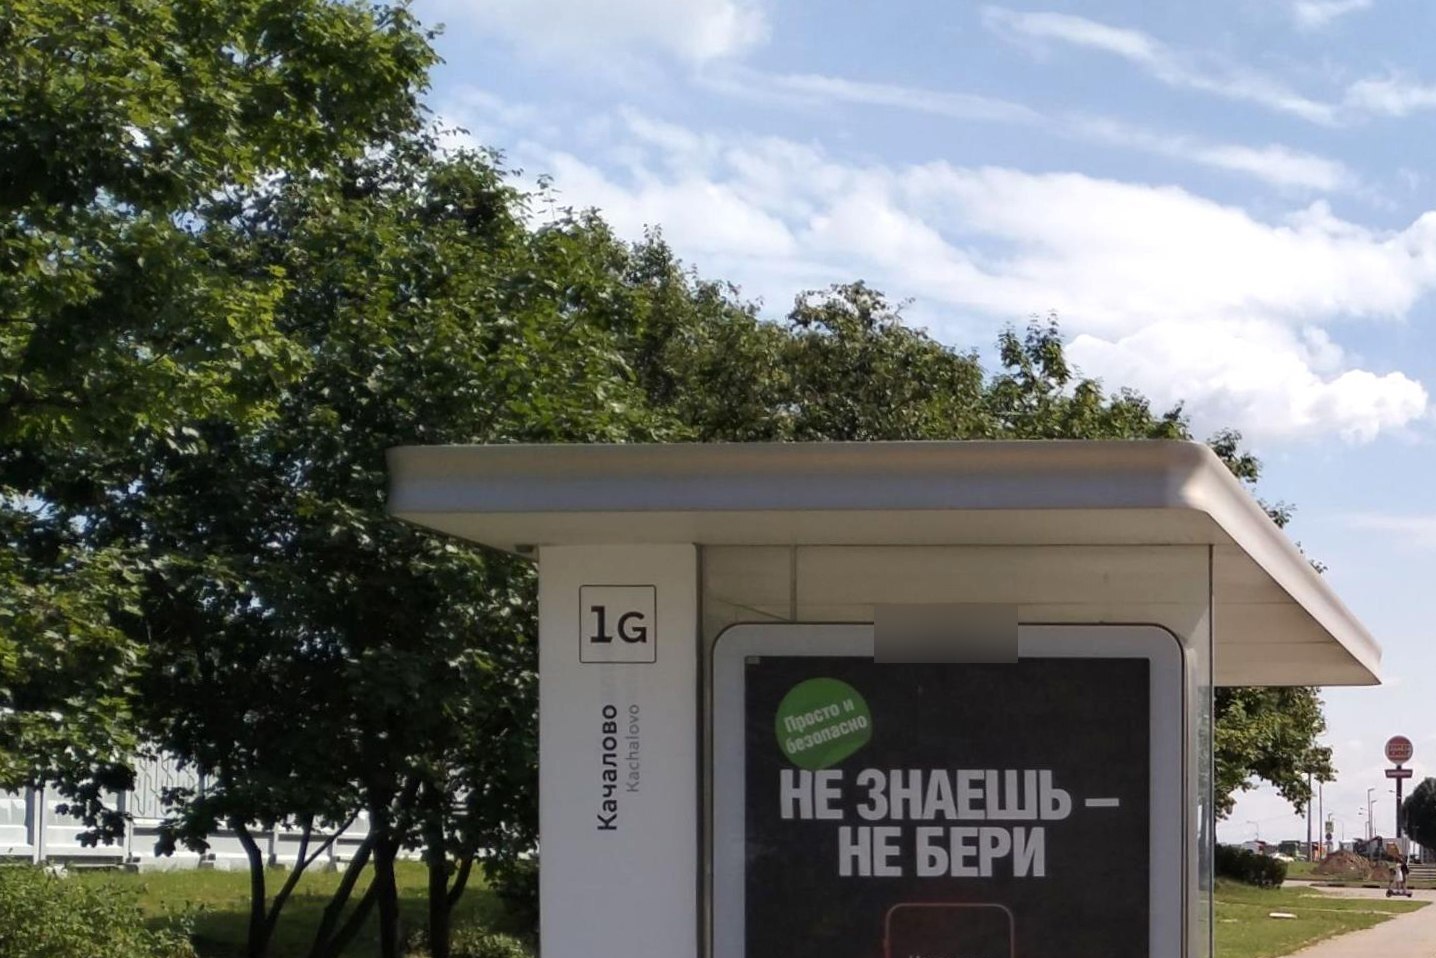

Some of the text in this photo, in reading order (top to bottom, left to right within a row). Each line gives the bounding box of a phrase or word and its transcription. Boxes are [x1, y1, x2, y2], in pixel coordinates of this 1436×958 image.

[590, 605, 648, 644] 1G
[784, 698, 855, 733] Просто и
[785, 715, 868, 754] безопасно
[597, 704, 618, 831] Качалово
[626, 704, 640, 793] Kachalovo
[779, 769, 844, 820] НЕ
[856, 768, 1072, 820] ЗНАЕШЬ
[838, 826, 1046, 877] НЕ БЕРИ
